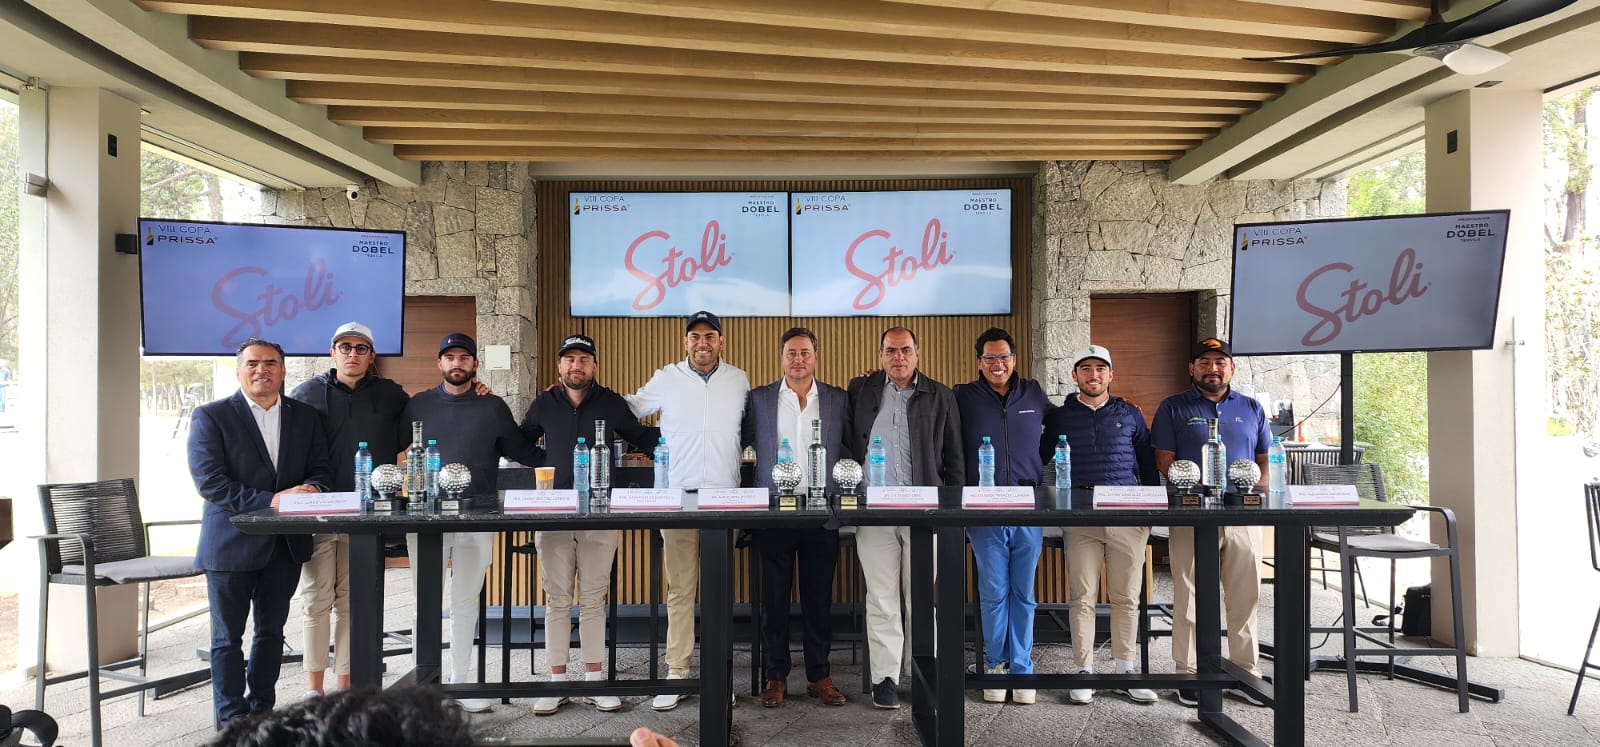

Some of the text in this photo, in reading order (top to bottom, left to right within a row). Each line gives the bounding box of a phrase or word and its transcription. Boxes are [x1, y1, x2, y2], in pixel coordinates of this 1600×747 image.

[599, 195, 625, 203] COPA
[820, 195, 846, 203] COPA
[158, 224, 212, 234] VIII COPA
[1253, 227, 1302, 237] VIII COPA
[1446, 229, 1495, 239] DOBEL
[157, 235, 216, 245] PRISSA
[1251, 237, 1305, 247] PRISSA
[352, 245, 395, 254] DOBEL
[624, 219, 732, 311] Stoli
[845, 217, 953, 310] Stoli
[211, 257, 340, 347] Stoli
[1295, 247, 1429, 347] Stoli
